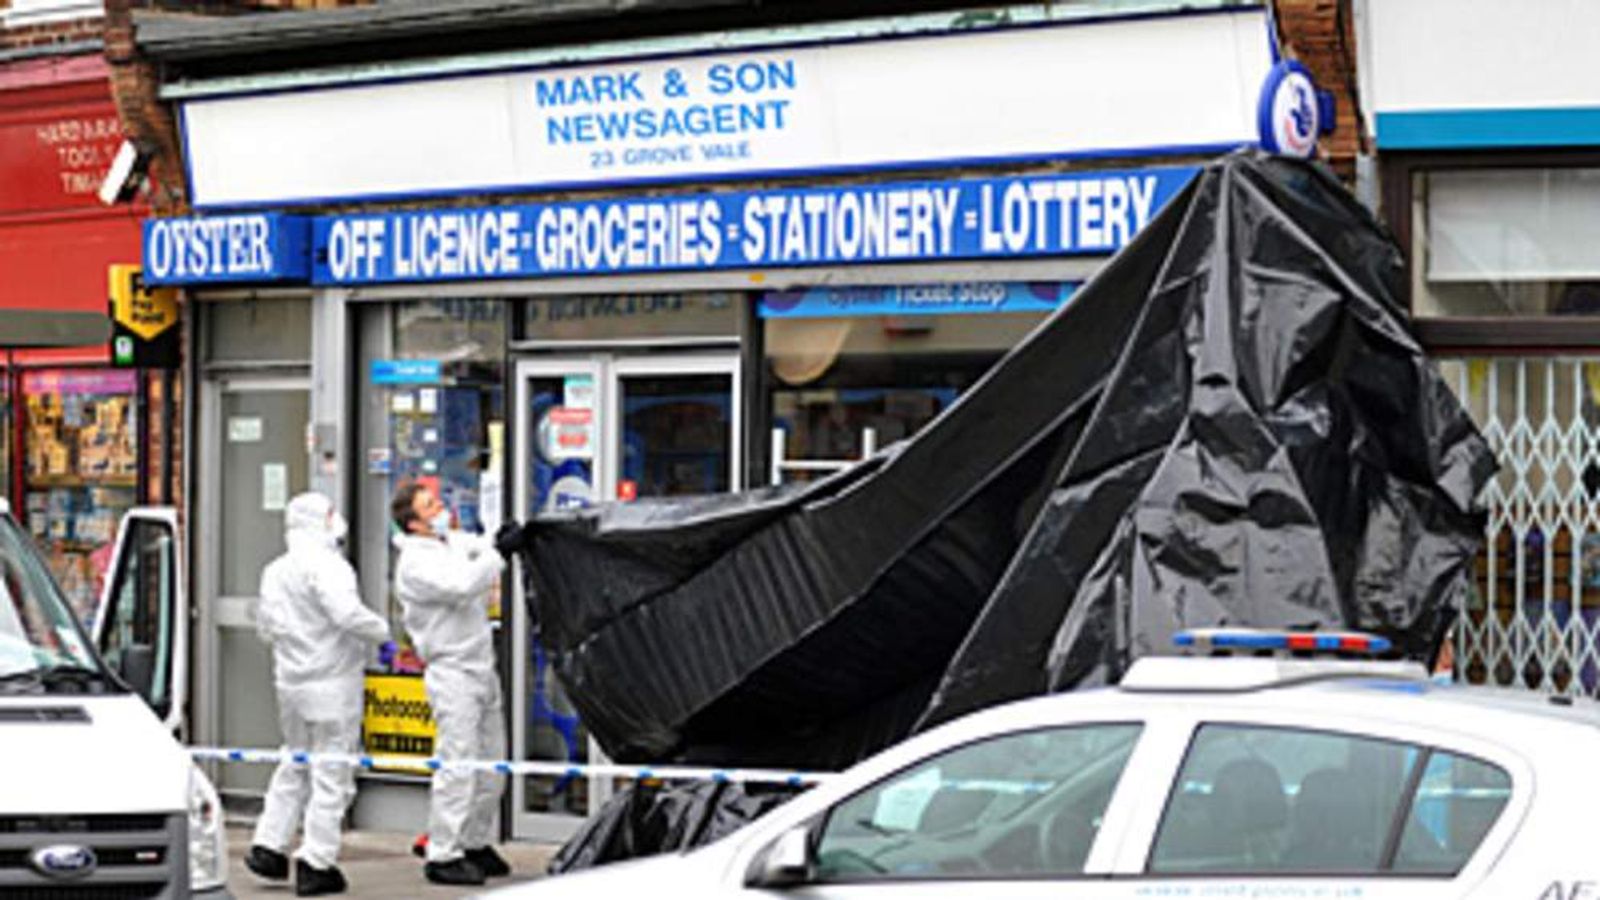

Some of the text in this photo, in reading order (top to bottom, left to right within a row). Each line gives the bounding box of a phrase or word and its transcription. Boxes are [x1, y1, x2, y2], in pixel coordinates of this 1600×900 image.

[535, 60, 796, 107] MARK & SON
[546, 100, 789, 144] NEWSAGENT
[590, 141, 751, 168] 23 GROVE VALE
[149, 215, 272, 278] OYSTER
[329, 177, 1157, 279] OFF LICENCE GROCERIES STATIONERY LOTTERY
